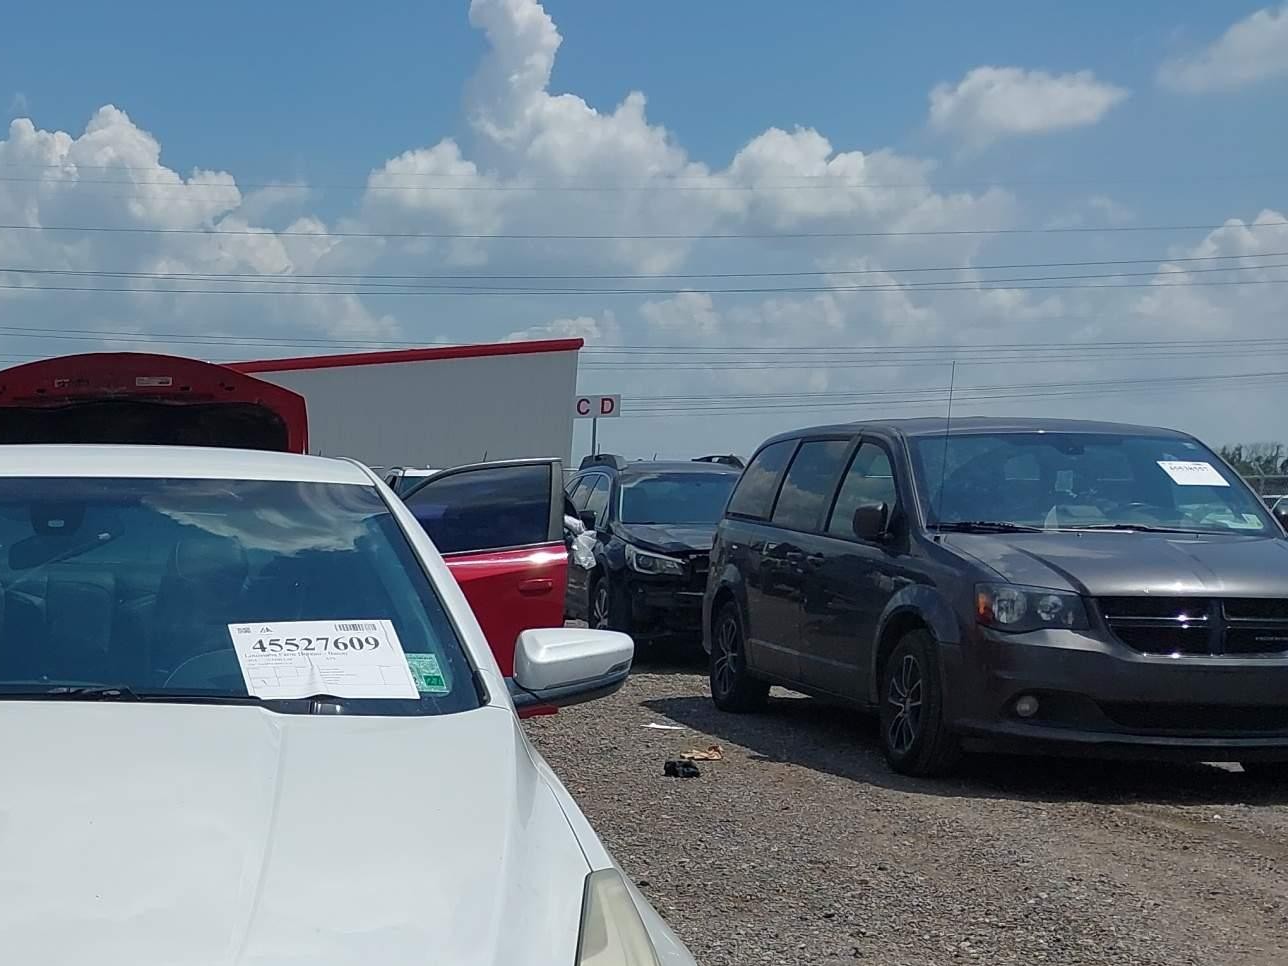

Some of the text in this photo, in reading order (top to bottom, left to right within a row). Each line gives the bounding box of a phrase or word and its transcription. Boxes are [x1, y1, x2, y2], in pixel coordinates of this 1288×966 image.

[577, 398, 614, 415] C D
[252, 636, 380, 653] 45527609
